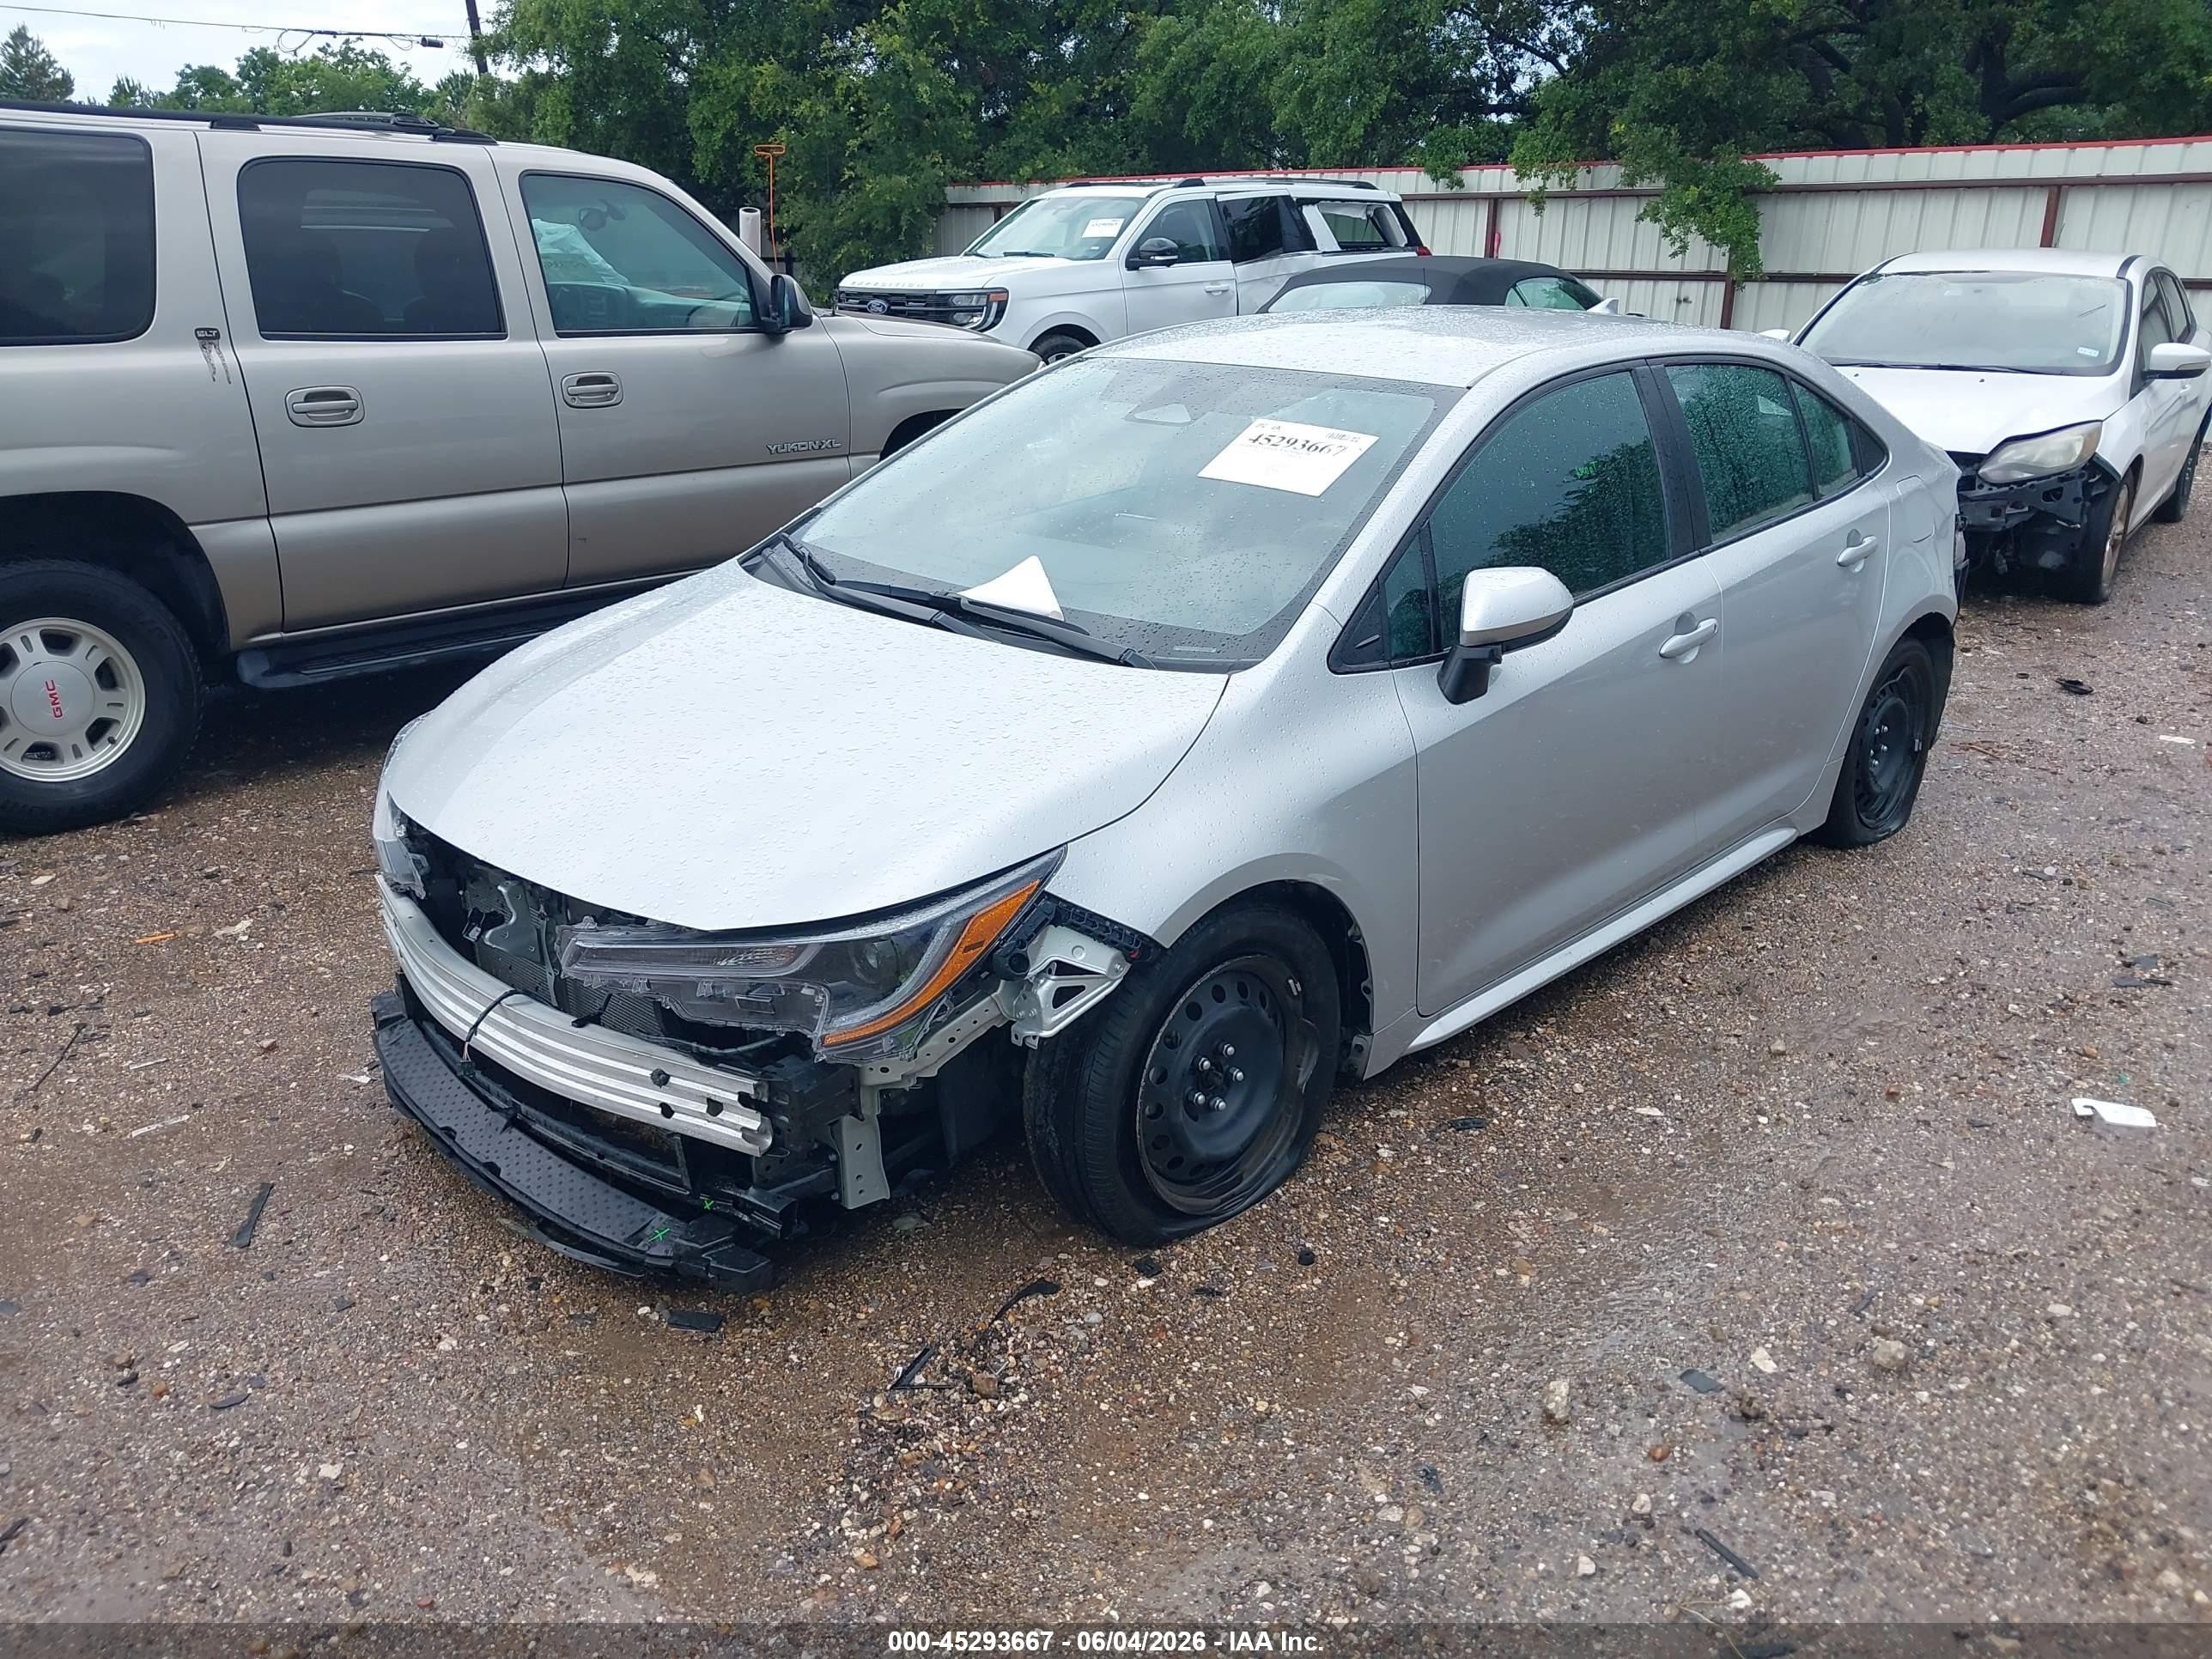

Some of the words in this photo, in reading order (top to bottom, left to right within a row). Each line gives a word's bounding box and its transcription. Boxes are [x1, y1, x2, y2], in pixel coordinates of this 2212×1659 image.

[767, 441, 819, 455] YUKON
[1248, 434, 1349, 457] 45293667
[45, 679, 64, 720] GMC
